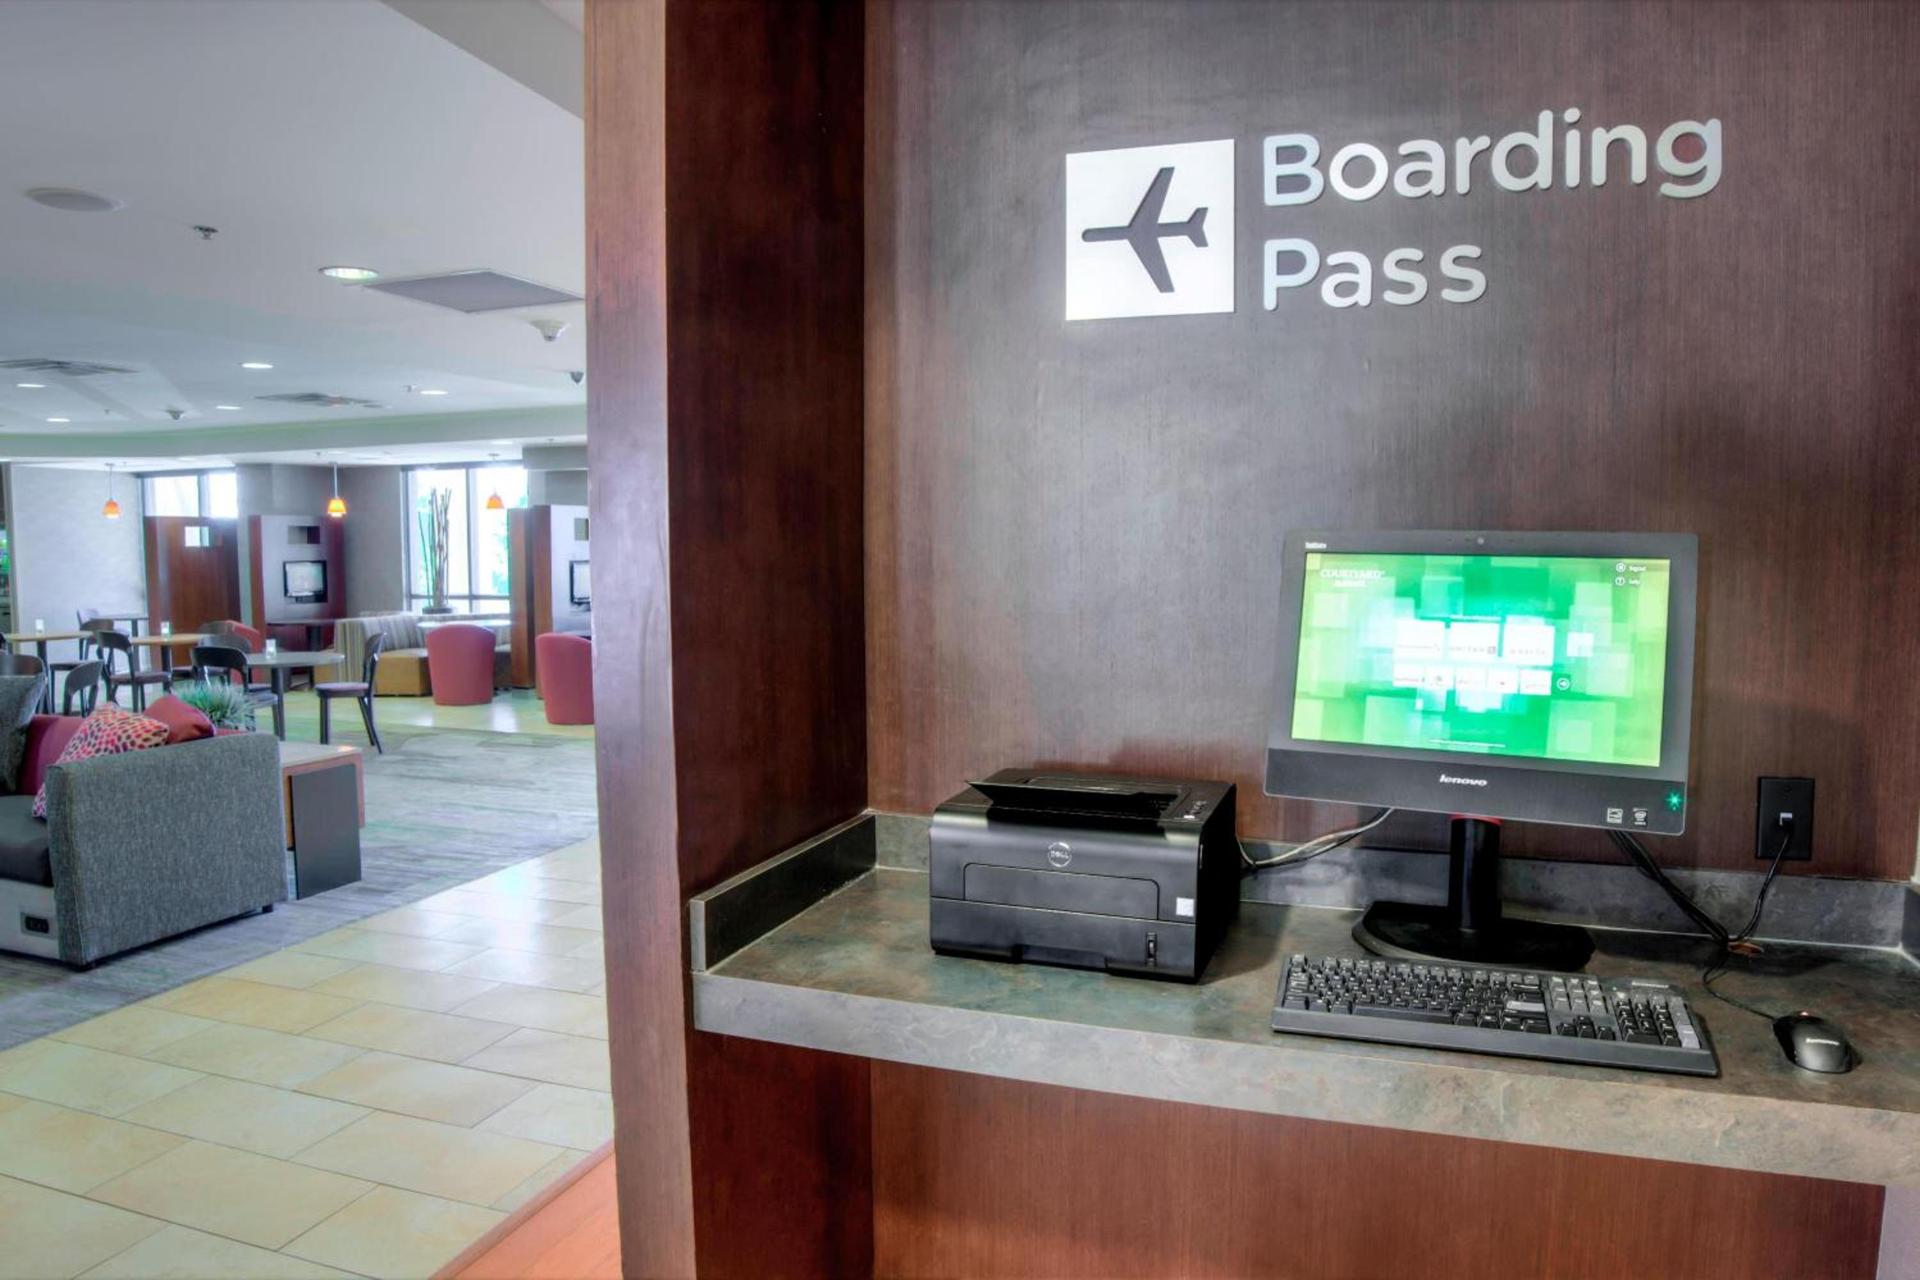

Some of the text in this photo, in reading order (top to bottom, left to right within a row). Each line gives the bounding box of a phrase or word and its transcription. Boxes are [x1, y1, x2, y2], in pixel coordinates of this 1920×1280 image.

[1263, 108, 1722, 206] Boarding
[1263, 238, 1487, 311] Pass
[1439, 773, 1488, 787] lenovo
